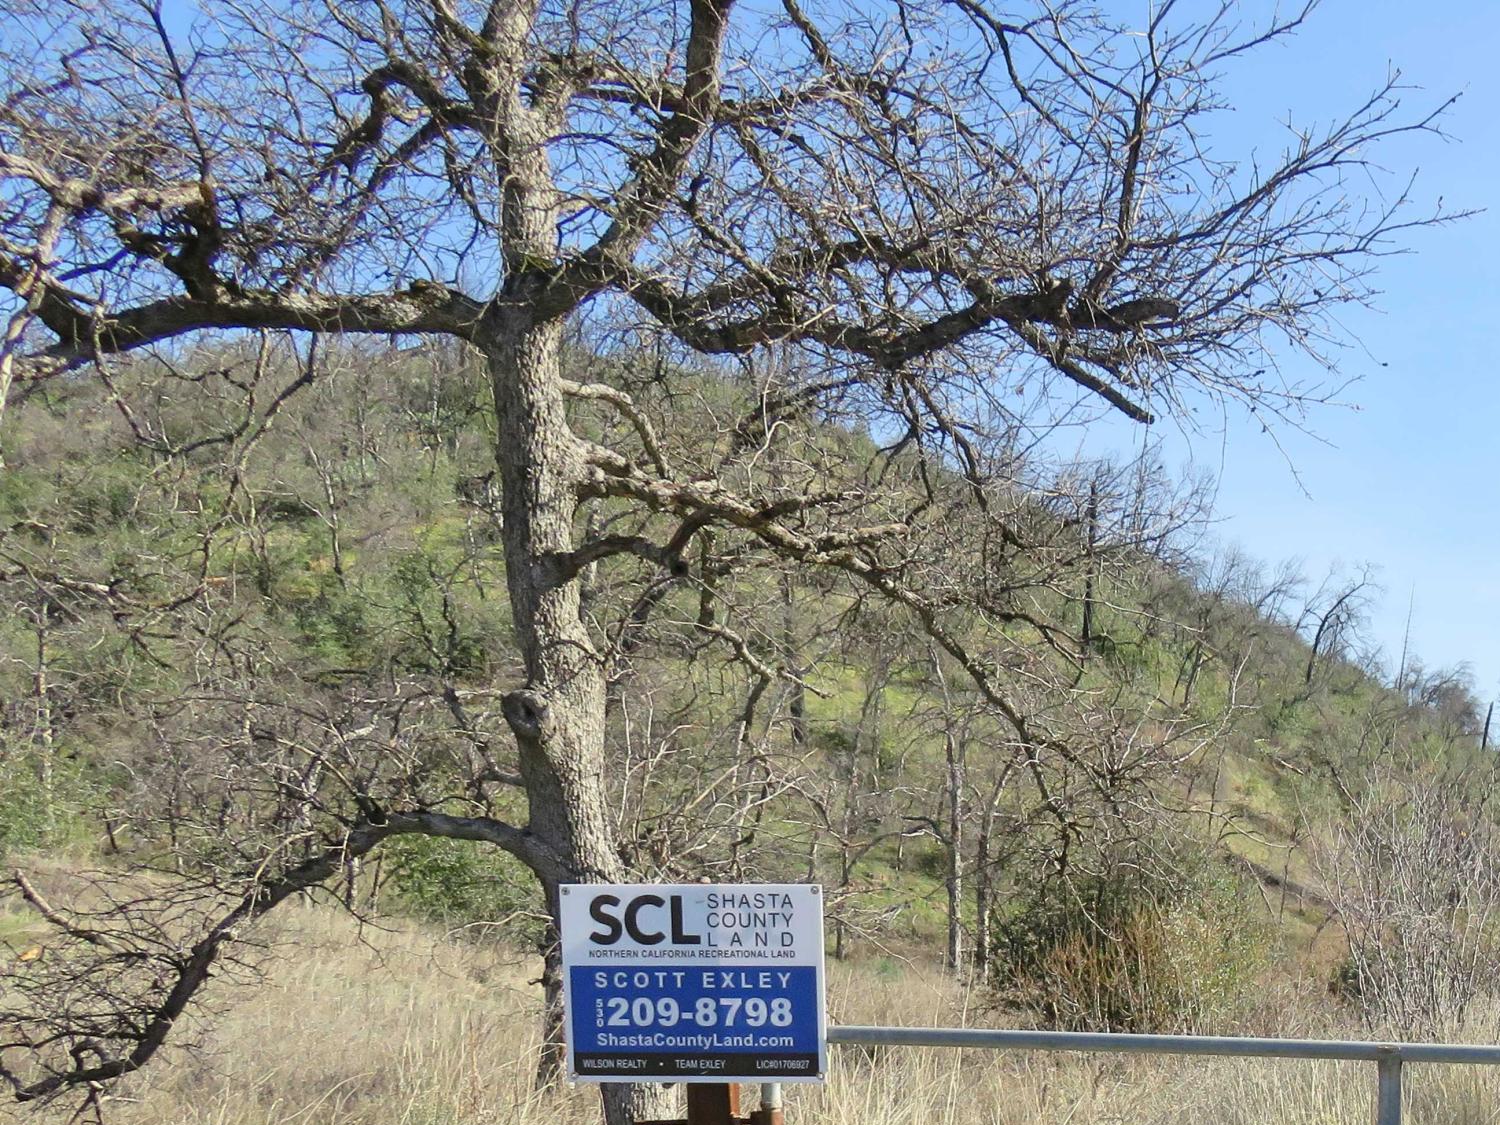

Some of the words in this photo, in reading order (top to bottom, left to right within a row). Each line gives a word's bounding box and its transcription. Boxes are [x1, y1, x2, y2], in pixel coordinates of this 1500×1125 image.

[707, 894, 794, 909] SHASTA
[589, 894, 701, 945] SCL
[707, 912, 794, 928] COUNTY
[708, 932, 794, 947] LAND
[589, 950, 639, 959] NORTHERN
[641, 950, 696, 959] CALIFORNIA
[699, 950, 768, 959] RECREATIONAL
[771, 950, 796, 959] LAND
[595, 972, 685, 988] SCOTT
[702, 972, 791, 988] EXLEY
[607, 998, 793, 1027] 209-8798
[597, 1033, 794, 1049] ShastaCountyLand.com
[583, 1059, 615, 1069] WILSON
[617, 1059, 648, 1069] REALTY
[675, 1059, 698, 1069] TEAM
[700, 1059, 726, 1069] EXLEY
